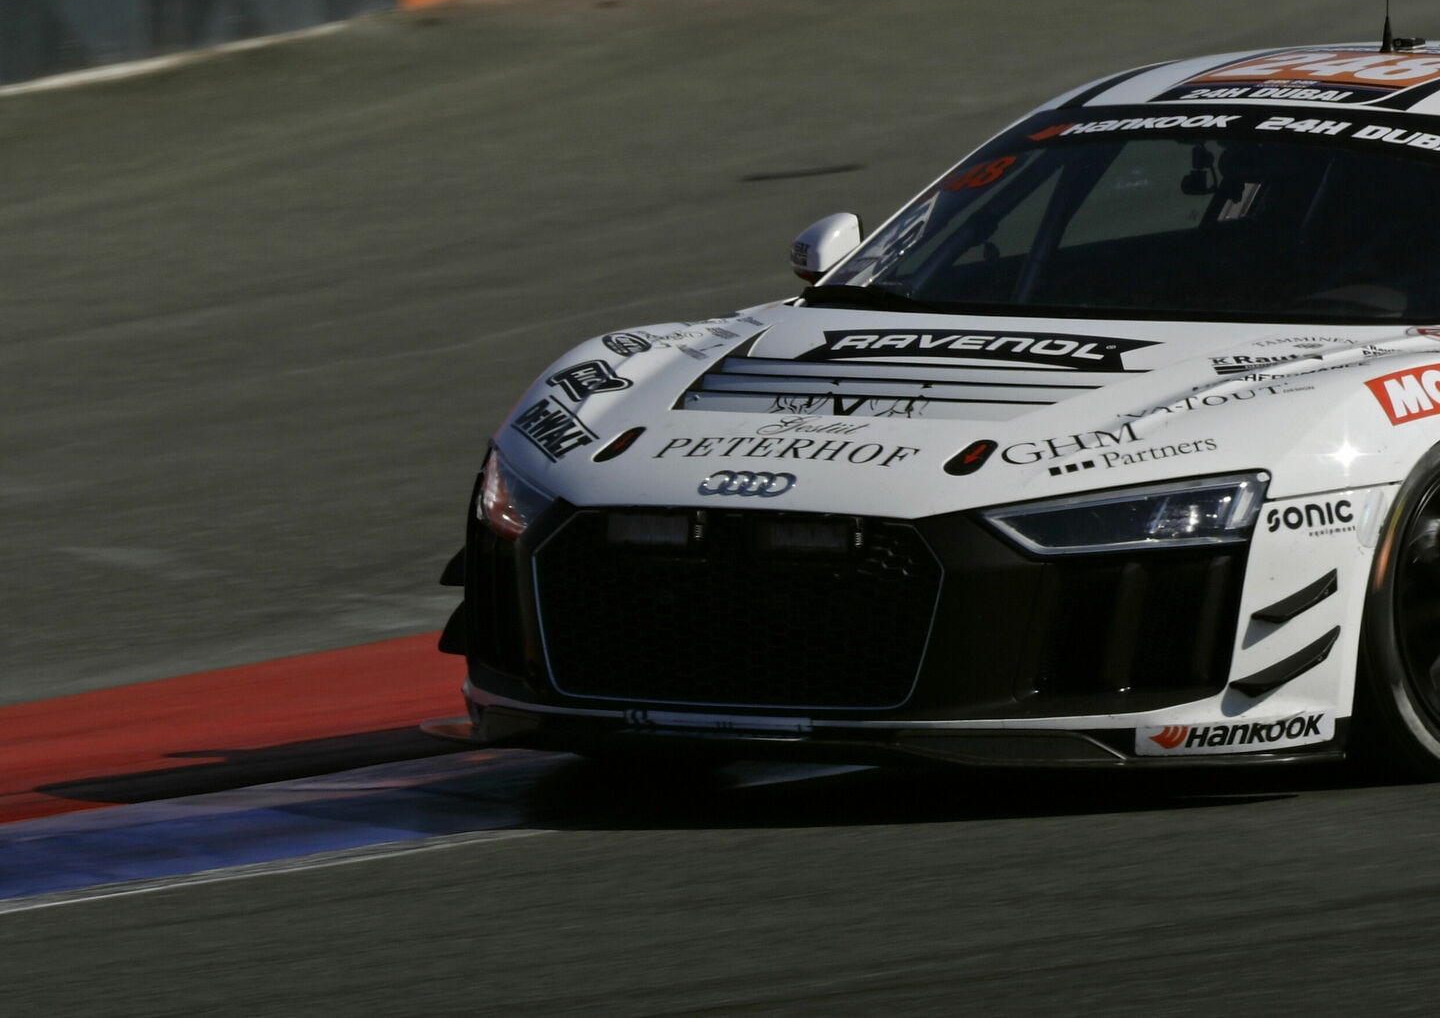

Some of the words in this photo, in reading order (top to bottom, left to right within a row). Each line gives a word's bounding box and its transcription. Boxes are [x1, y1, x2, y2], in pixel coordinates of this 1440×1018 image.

[1189, 88, 1247, 101] 24H
[1250, 86, 1354, 102] DUBAI
[1254, 115, 1346, 138] 24H
[830, 333, 1105, 361] RAVENOL
[652, 435, 921, 468] PETERHOF
[1000, 422, 1147, 466] GHM
[1103, 436, 1219, 470] Partners
